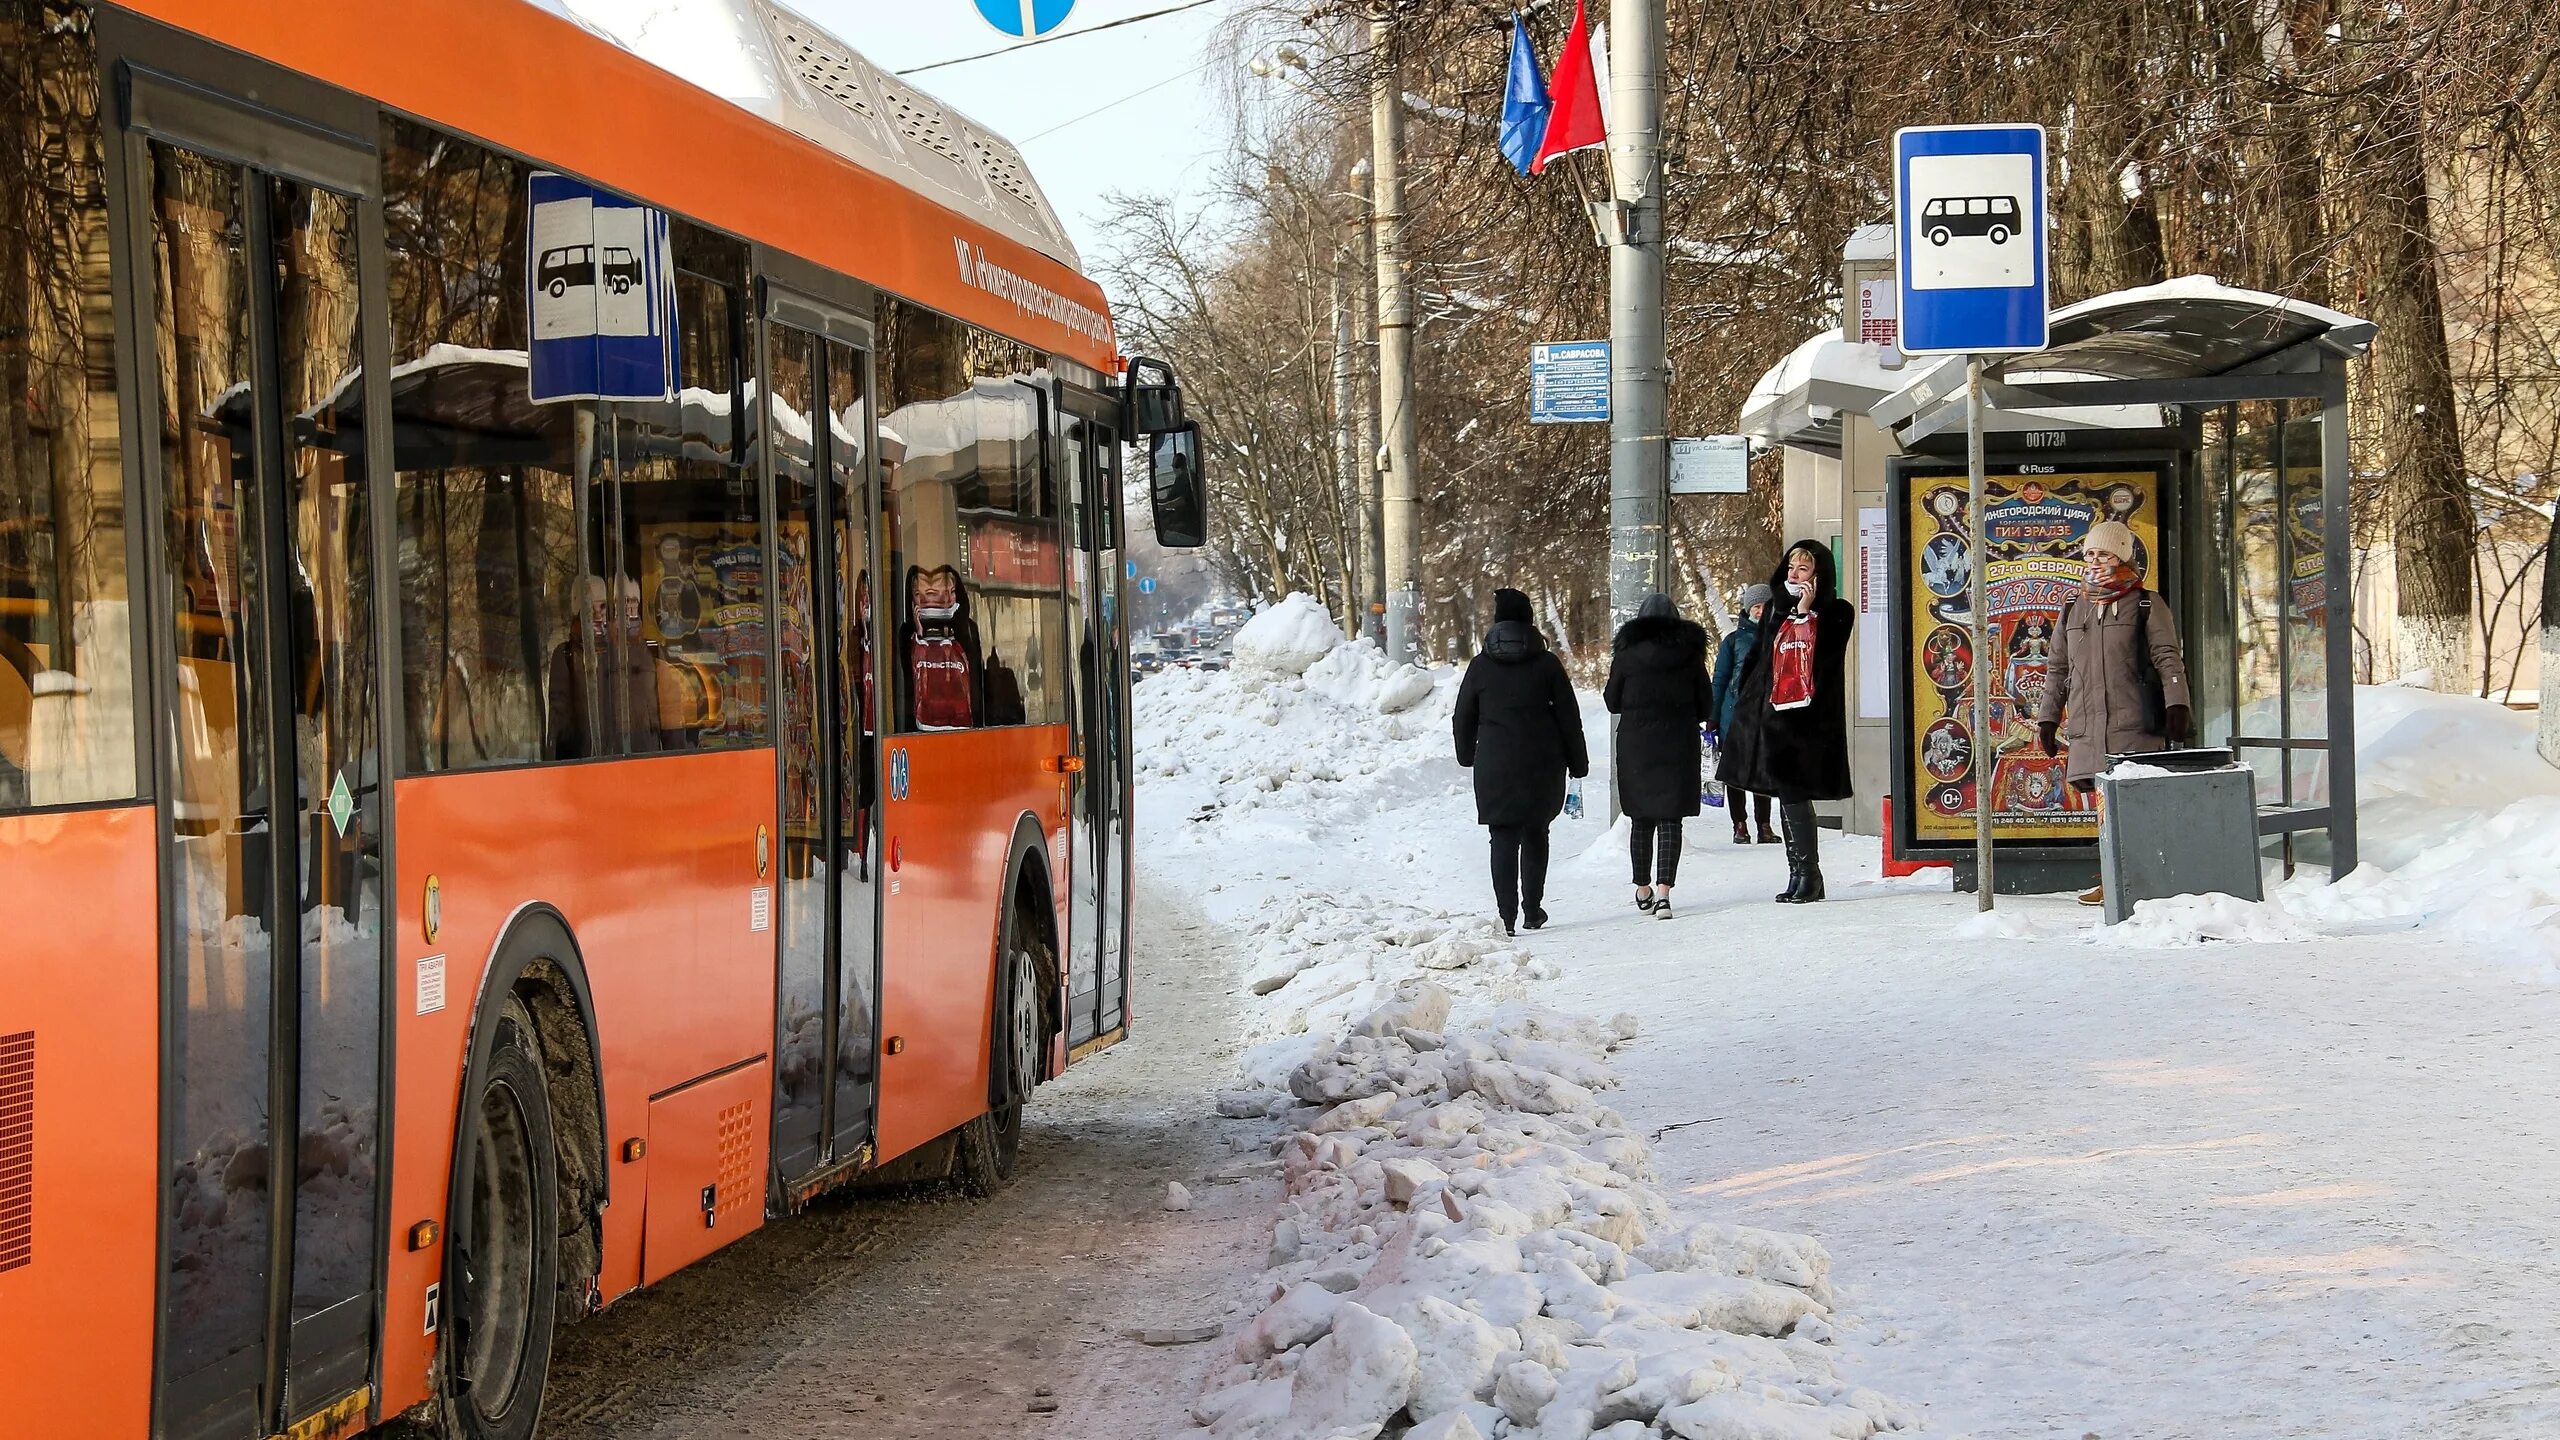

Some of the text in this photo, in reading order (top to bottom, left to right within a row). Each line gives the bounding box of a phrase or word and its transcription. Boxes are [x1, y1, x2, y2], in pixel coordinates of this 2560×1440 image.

[1534, 388, 1544, 399] 37
[1534, 400, 1544, 411] 51
[2030, 464, 2055, 474] Russ
[1984, 504, 2091, 522] ИЖЕГОРОДСКИЙ ЦИРК
[2023, 525, 2073, 537] ЭРАДЗЕ
[1989, 564, 2023, 577] 27-го
[1987, 581, 2081, 609] УРЛЕС
[2019, 680, 2046, 690] Circu
[1943, 793, 1960, 805] 0+
